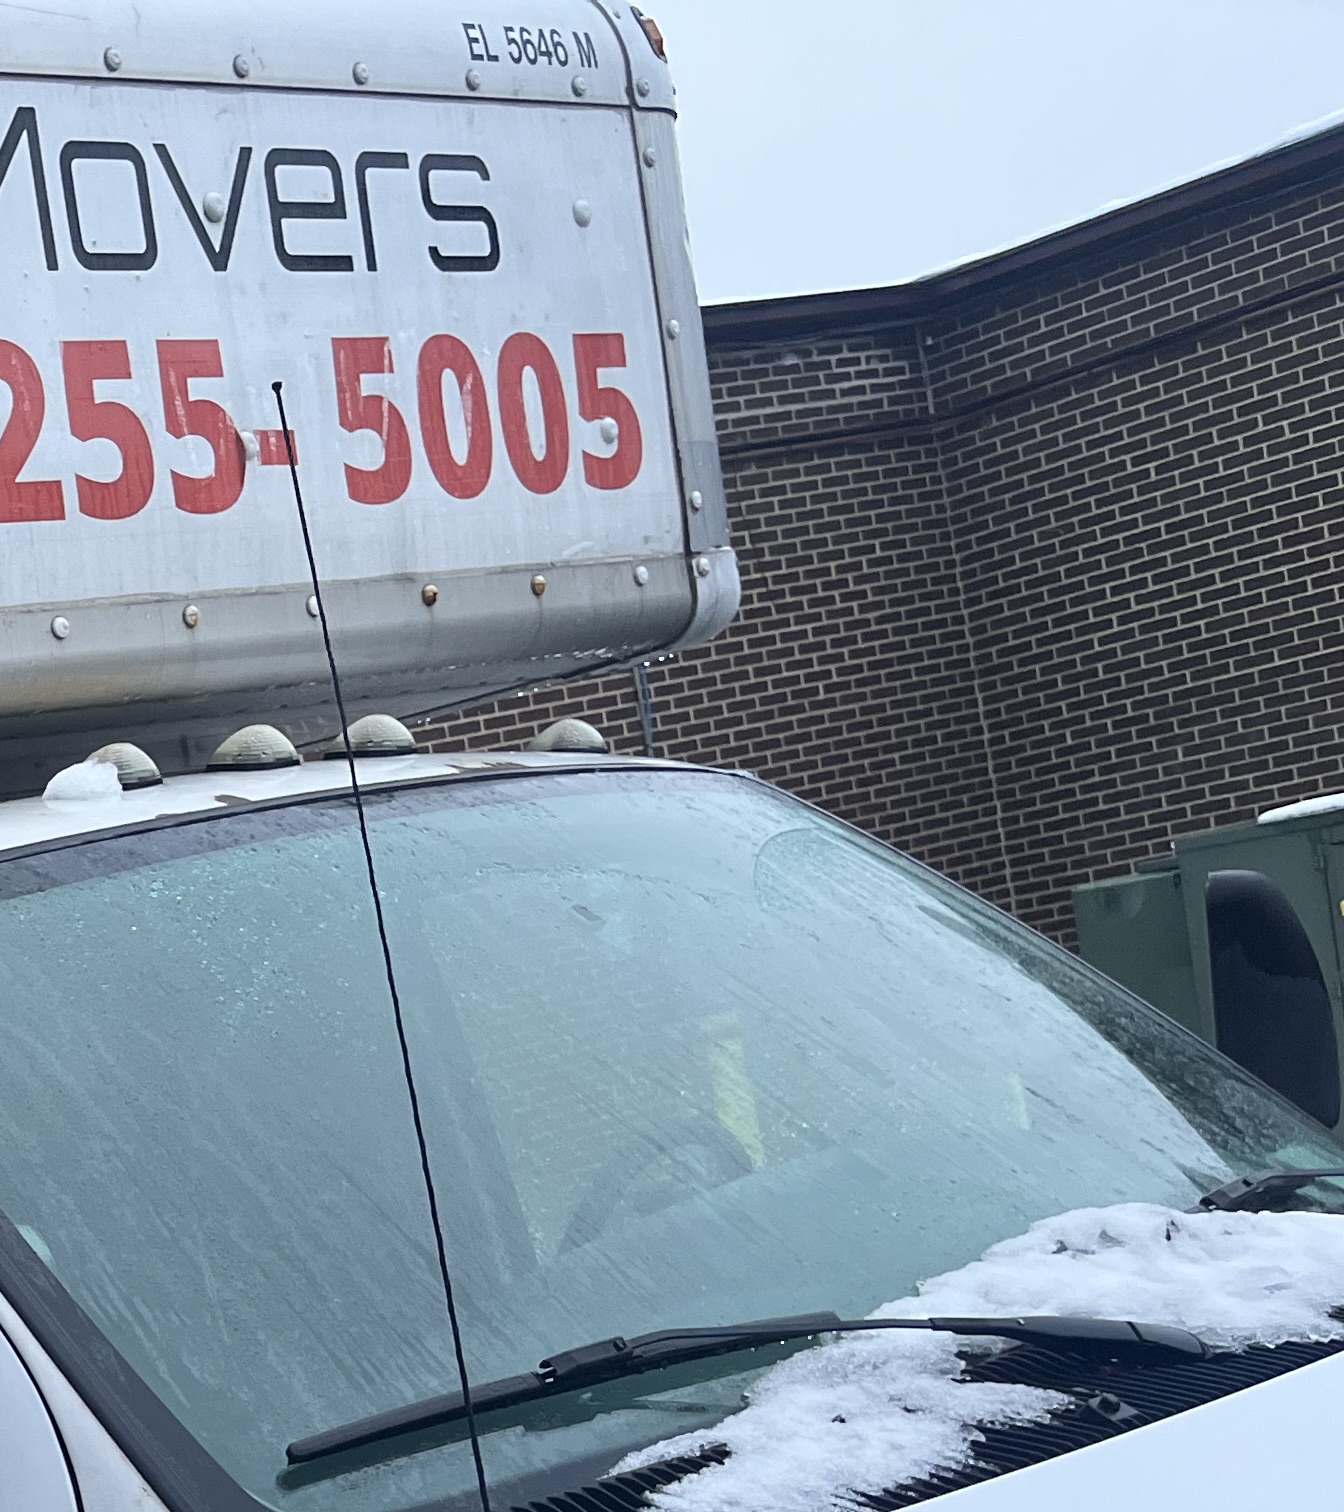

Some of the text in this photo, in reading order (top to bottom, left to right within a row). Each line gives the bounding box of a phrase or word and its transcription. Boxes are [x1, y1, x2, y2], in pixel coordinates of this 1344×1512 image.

[461, 22, 599, 69] EL 5646 M
[333, 332, 644, 504] 5005
